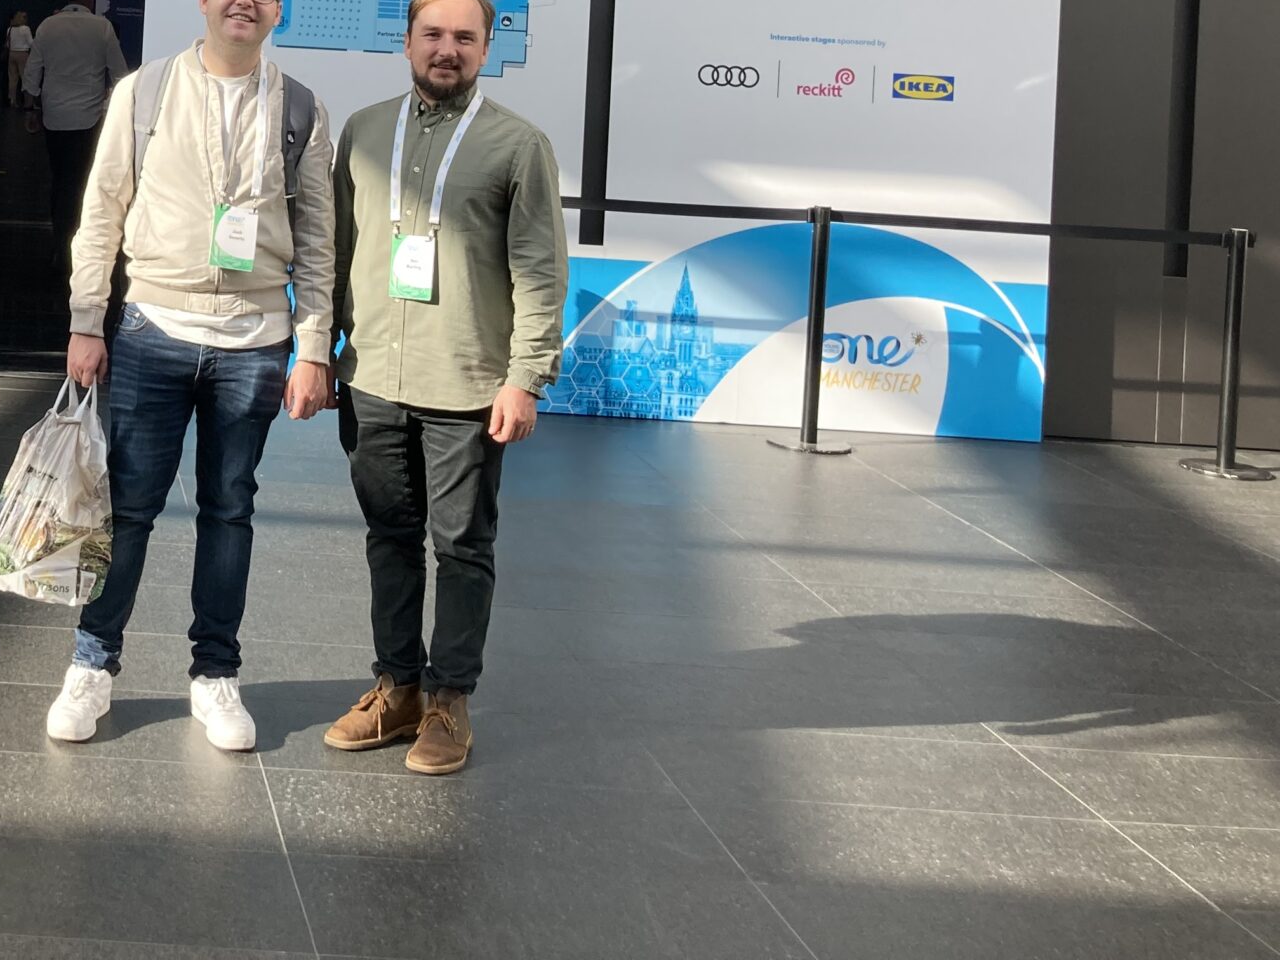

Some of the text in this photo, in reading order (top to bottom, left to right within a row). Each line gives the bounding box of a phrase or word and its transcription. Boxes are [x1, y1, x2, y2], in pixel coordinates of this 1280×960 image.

[770, 33, 886, 48] Interactive stages sponsored by
[797, 82, 843, 98] reckitt
[898, 79, 950, 94] IKEA
